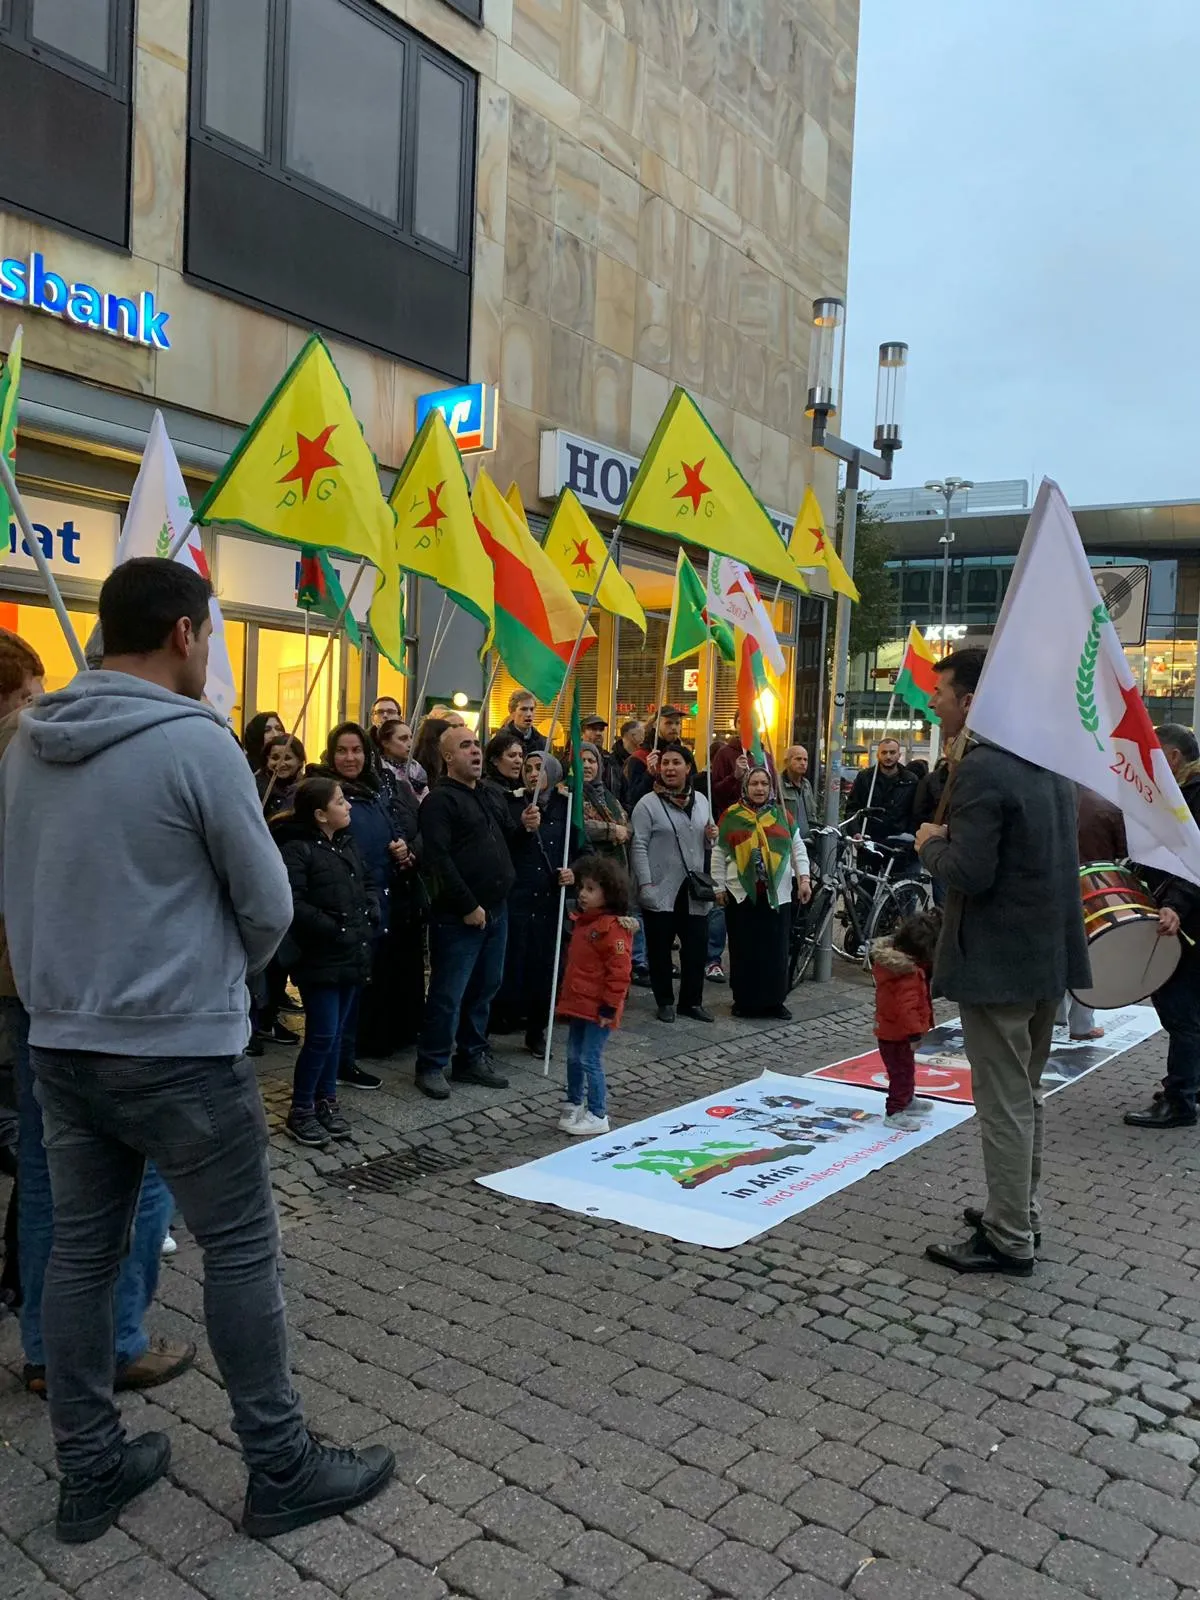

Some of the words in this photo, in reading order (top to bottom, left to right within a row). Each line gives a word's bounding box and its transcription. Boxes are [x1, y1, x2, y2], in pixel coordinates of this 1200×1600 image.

[0, 252, 171, 349] sbank
[923, 625, 968, 641] KFC
[1109, 751, 1154, 804] 2003
[721, 1183, 758, 1199] in
[746, 1163, 805, 1189] Afrin
